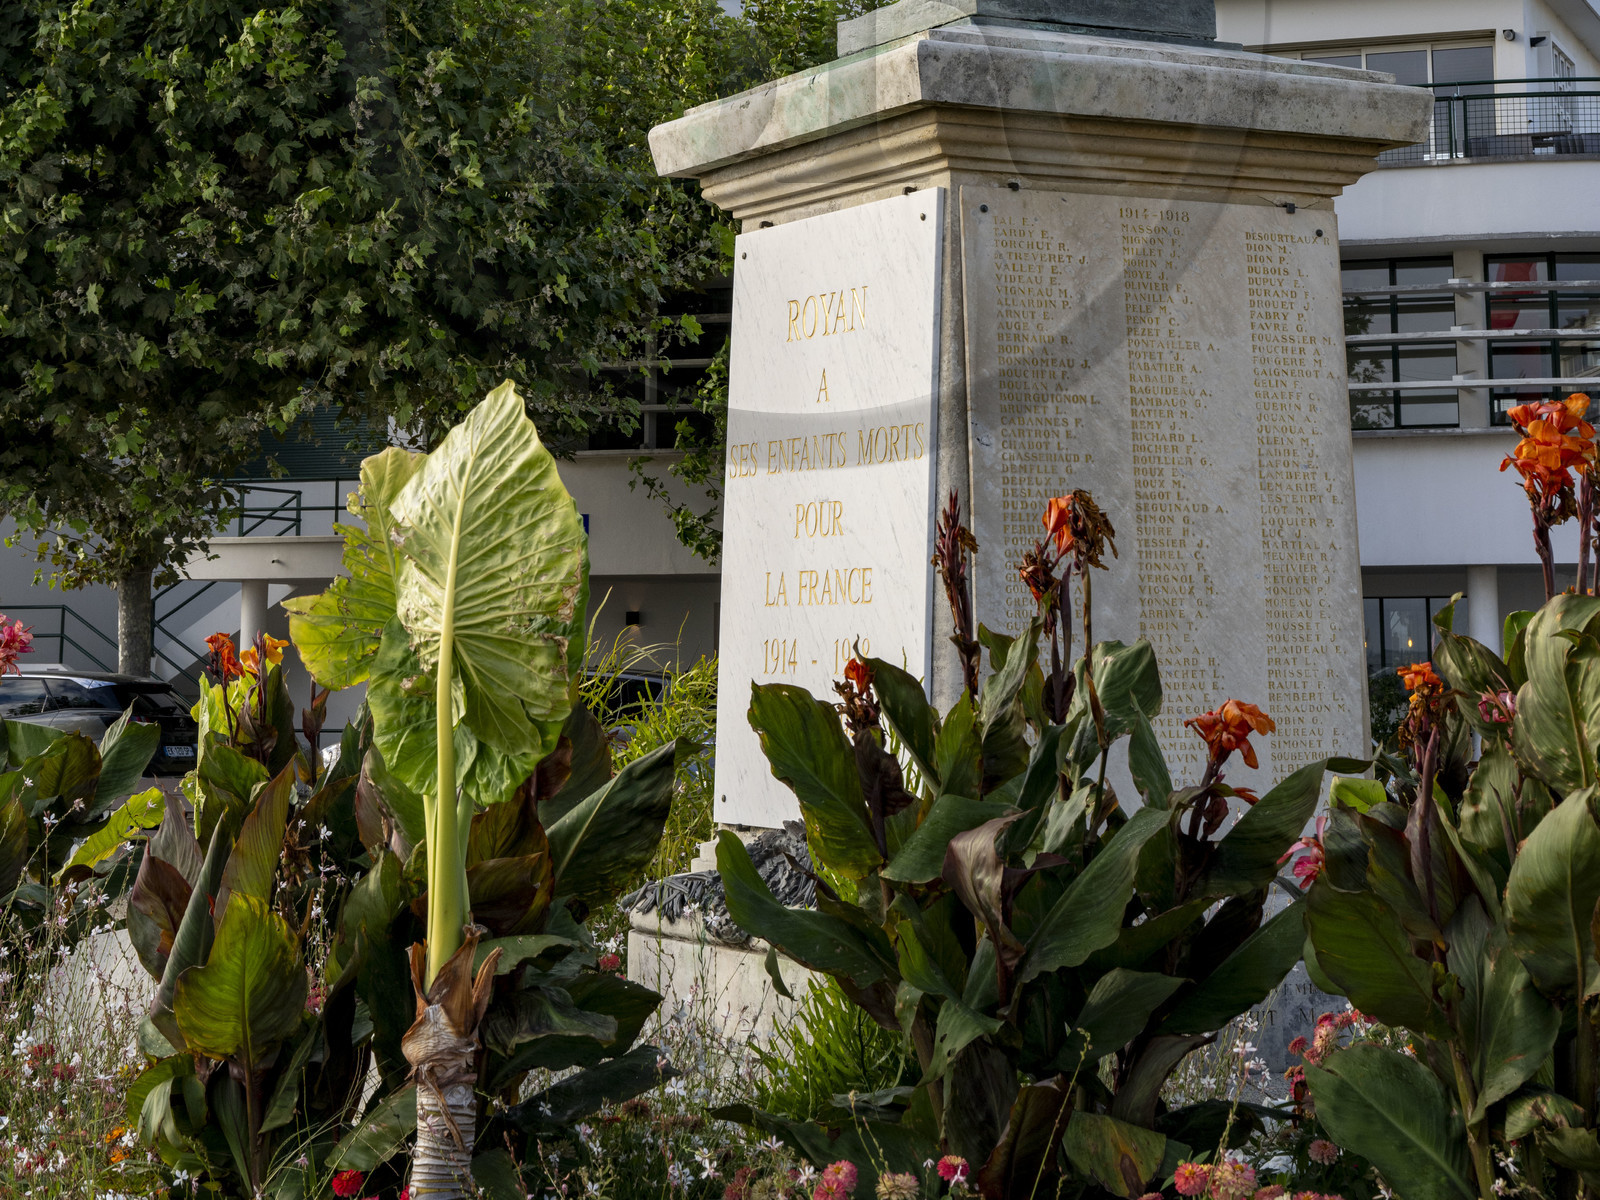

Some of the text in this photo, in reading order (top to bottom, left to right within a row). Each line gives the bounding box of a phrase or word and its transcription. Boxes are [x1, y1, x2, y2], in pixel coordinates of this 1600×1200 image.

[1119, 207, 1190, 223] 1914-1918
[994, 227, 1033, 239] TARDY
[1121, 223, 1169, 235] MASSON
[995, 239, 1051, 251] TORCHUT
[1122, 234, 1164, 246] MIGNON
[1122, 246, 1162, 257] MILLET
[1246, 242, 1273, 253] DION
[1123, 257, 1157, 268] MORIN
[1246, 253, 1273, 264] DION
[995, 262, 1043, 274] VALLET
[1247, 265, 1290, 276] DUBOIS
[995, 273, 1043, 285] VIDEAU
[1124, 269, 1150, 279] MOYE
[1124, 280, 1169, 292] OLIVIER
[1248, 276, 1285, 287] DUPUY
[1248, 287, 1297, 299] DURAND
[997, 297, 1058, 309] ALLARDIN
[1125, 303, 1152, 314] PELE
[1249, 299, 1295, 310] DROUET
[786, 285, 869, 343] ROYAN
[997, 309, 1036, 320] ARNUT
[1250, 310, 1289, 321] FABRY
[997, 320, 1029, 331] AUGE
[1126, 315, 1160, 326] PENOT
[1127, 326, 1159, 337] PEZET
[1250, 321, 1288, 332] FAVRE
[997, 332, 1055, 344] BERNARD
[997, 344, 1034, 355] BODIN
[1127, 338, 1201, 351] PONTAILLER
[1128, 350, 1163, 360] POTET
[998, 356, 1075, 369] BONNOMEAU
[1129, 373, 1175, 384] RABAUD
[1253, 367, 1320, 379] GAIGNEROT
[816, 367, 830, 403] A
[999, 380, 1048, 391] BOULAN
[1253, 378, 1288, 389] GELIN
[1129, 385, 1196, 397] RAGUIDEAU
[999, 392, 1087, 405] BOURGUIGNON
[1130, 396, 1187, 408] RAMBAUD
[1130, 408, 1175, 419] RATIER
[1000, 416, 1069, 427] CABANNES
[1131, 420, 1162, 430] REMY
[1001, 428, 1060, 439] CARTRON
[1131, 431, 1185, 443] RICHARD
[1257, 436, 1294, 446] KLEIN
[729, 422, 924, 479] SES ENFANTS MORTS
[1132, 443, 1179, 454] ROCHER
[1258, 459, 1300, 469] LAFON
[1133, 467, 1164, 477] ROUX
[1258, 470, 1317, 481] LAMBERT
[1001, 476, 1052, 487] DEPEUX
[1134, 478, 1165, 489] ROUX
[1135, 490, 1170, 500] SAGOT
[1135, 502, 1209, 513] SEGUINAUD
[1260, 505, 1289, 515] LIOT
[794, 500, 844, 539] POUR
[1136, 514, 1175, 524] SIMON
[1136, 526, 1171, 536] SUIRE
[1261, 528, 1284, 538] LUC
[1137, 538, 1187, 548] TESSIER
[1261, 540, 1319, 550] MARTIAL
[1138, 561, 1186, 571] TONNAY
[764, 567, 873, 607] LA FRANCE
[1138, 585, 1195, 595] VIGNAUX
[1139, 597, 1185, 607] YONNET
[1265, 598, 1312, 608] MOREAU
[1139, 609, 1186, 619] ARRIVE
[1265, 610, 1313, 619] MOREAU
[1266, 621, 1320, 631] MOUSSET
[1266, 633, 1320, 643] MOUSSET
[1267, 645, 1328, 654] PLAIDEAU
[763, 638, 798, 675] 1914
[834, 637, 870, 676] 198
[1267, 657, 1297, 666] PRAT
[1268, 680, 1308, 689] RAULT
[1268, 692, 1323, 701] REMBERT
[1269, 704, 1331, 713] RENAUDON
[1270, 739, 1323, 748] SIMONET
